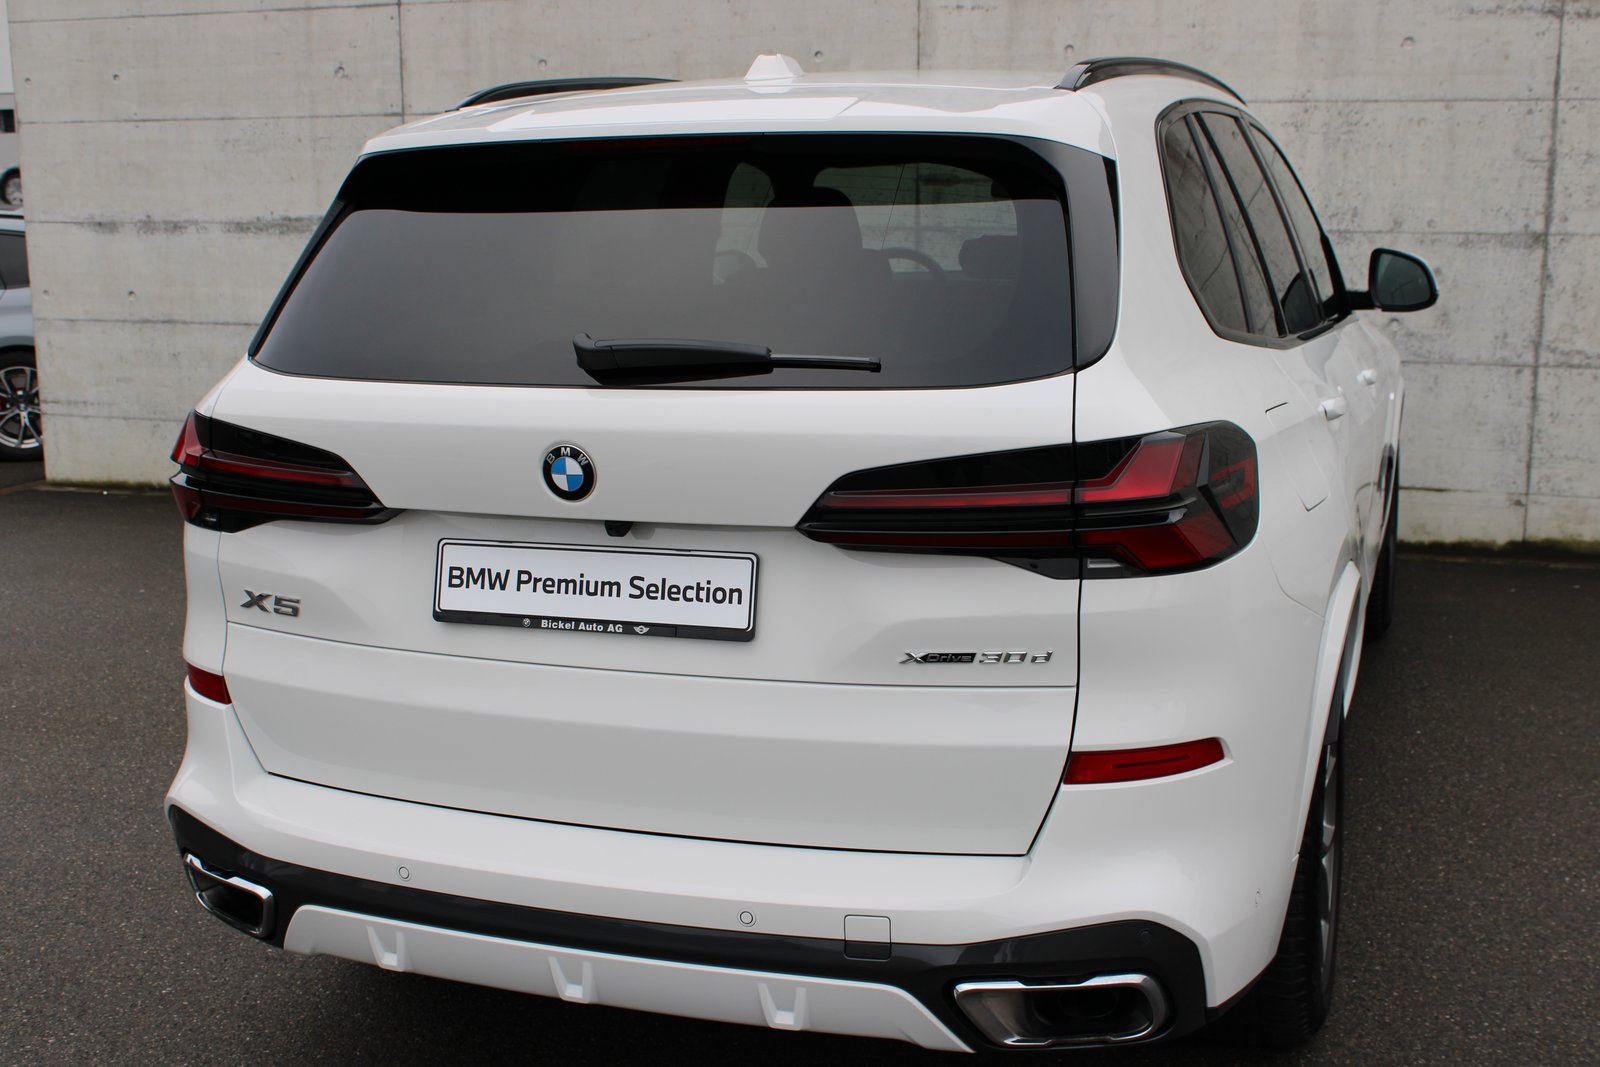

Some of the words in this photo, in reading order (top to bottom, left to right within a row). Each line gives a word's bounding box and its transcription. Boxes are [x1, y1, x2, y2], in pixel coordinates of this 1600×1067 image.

[546, 447, 589, 466] BMW
[448, 566, 510, 591] BMW
[516, 570, 621, 598] Premium
[628, 575, 743, 605] Selection
[240, 588, 301, 617] X5
[540, 619, 575, 630] Bickel
[578, 620, 604, 632] Auto
[607, 623, 623, 633] AG
